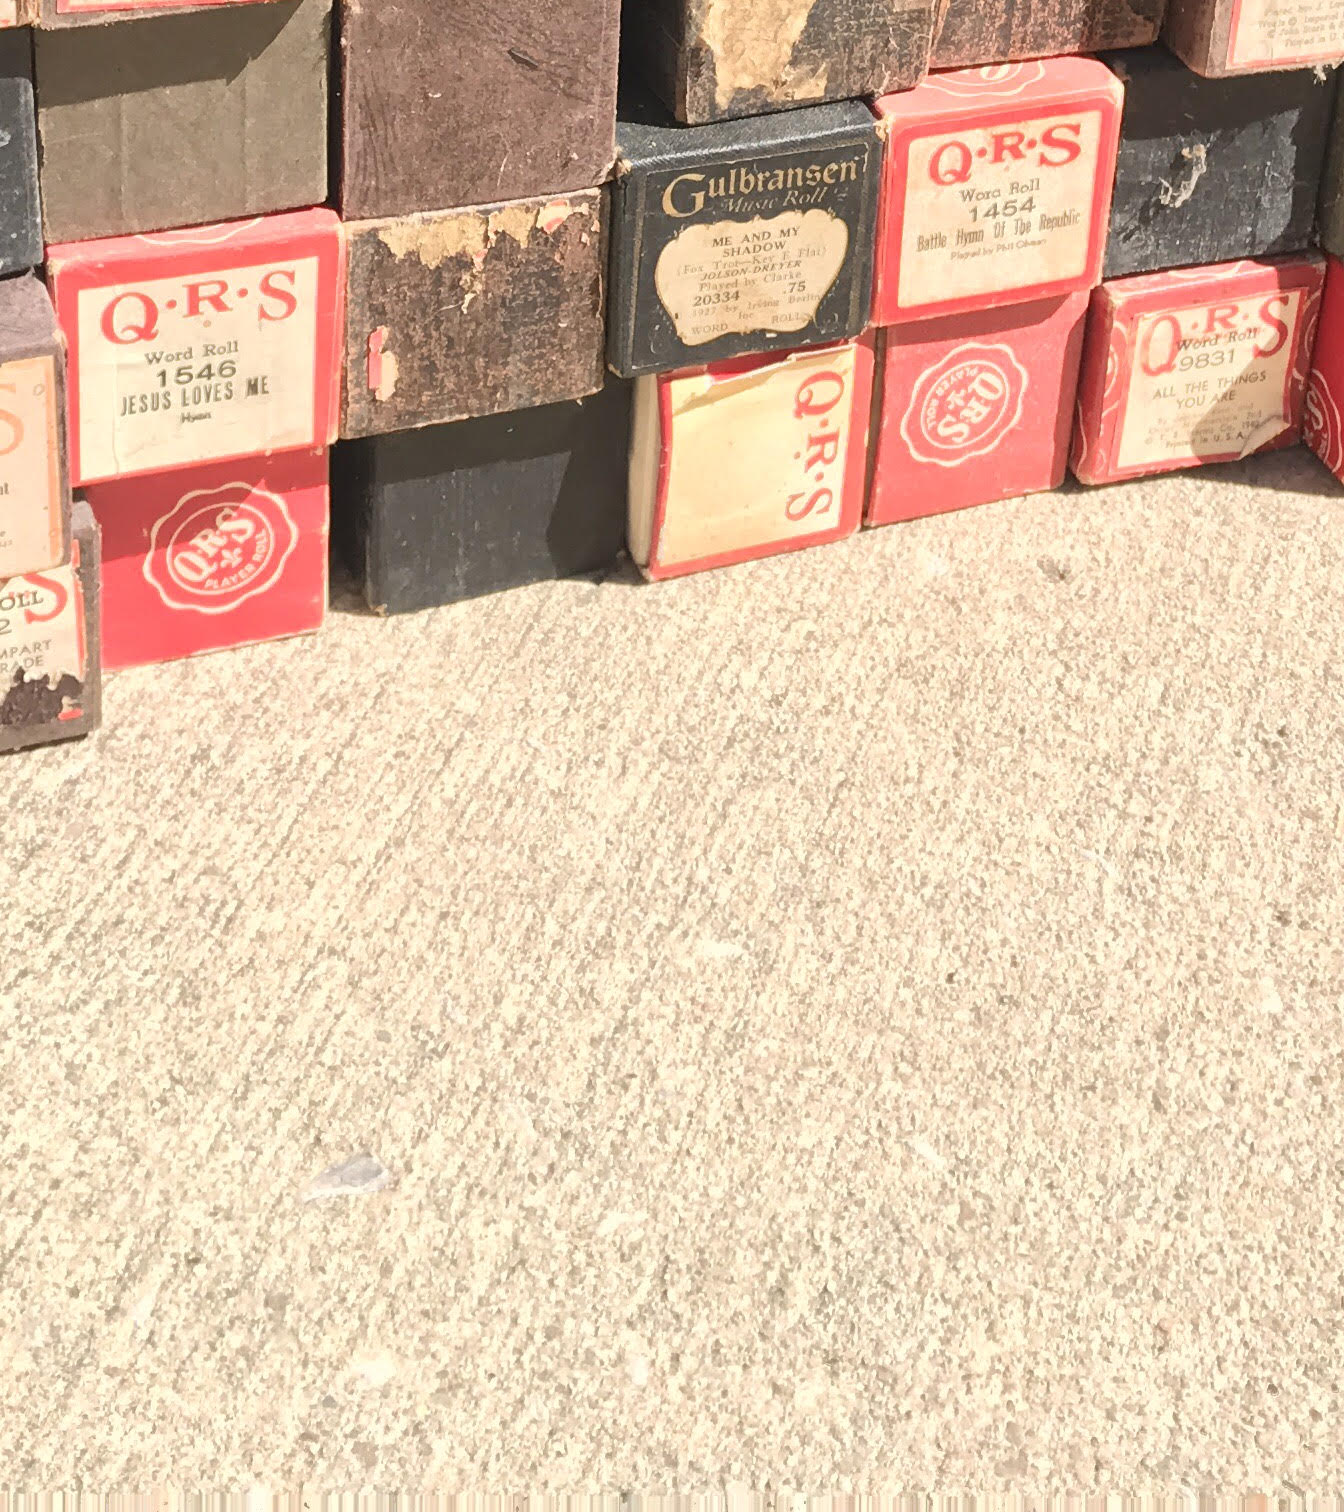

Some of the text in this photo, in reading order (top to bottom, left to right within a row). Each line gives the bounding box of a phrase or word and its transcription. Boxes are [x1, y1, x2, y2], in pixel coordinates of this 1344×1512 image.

[662, 157, 858, 217] Gulbransen
[968, 197, 1036, 223] 1454
[712, 227, 800, 247] ME AND MY
[916, 209, 1080, 252] Battle Hymn Of The Republic
[723, 241, 787, 257] SHADOW
[693, 291, 740, 307] 20334
[144, 340, 239, 365] Word Roll
[1179, 349, 1235, 372] 9831
[156, 360, 237, 388] 1546
[1153, 371, 1267, 400] ALL THE THINGS
[121, 376, 269, 417] JESUS LOVES ME
[1176, 391, 1237, 410] YOU ARE
